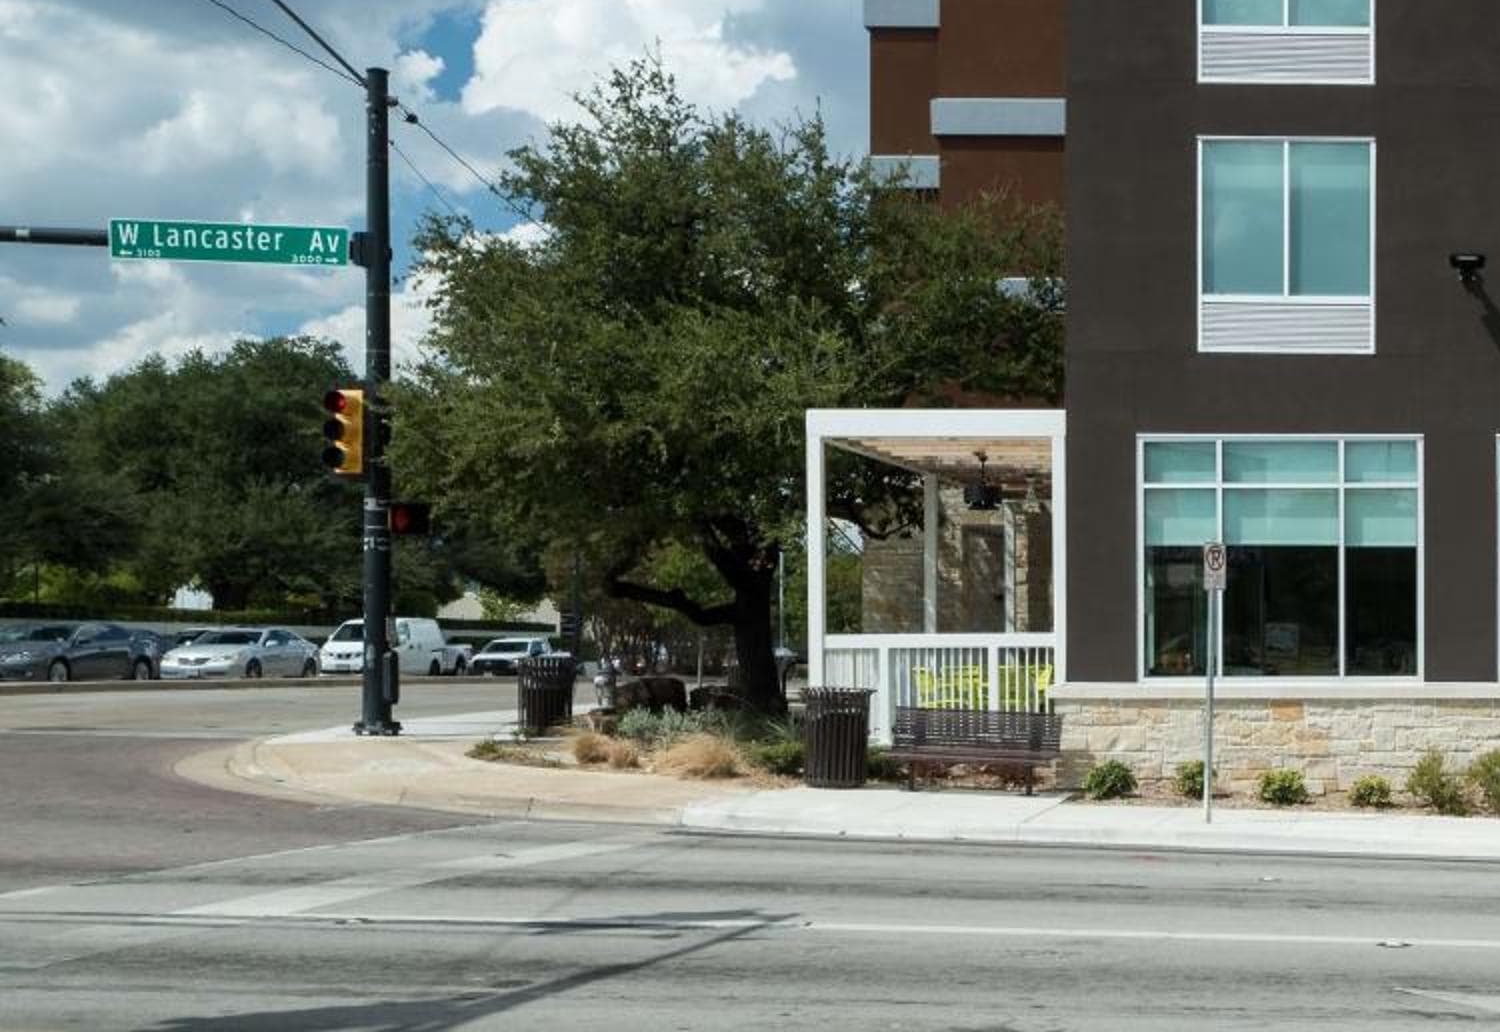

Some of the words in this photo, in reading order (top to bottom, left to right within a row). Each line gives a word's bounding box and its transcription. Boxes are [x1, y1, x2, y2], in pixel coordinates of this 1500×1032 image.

[117, 223, 139, 246] W
[153, 224, 284, 251] Lancaster
[309, 231, 340, 253] Av
